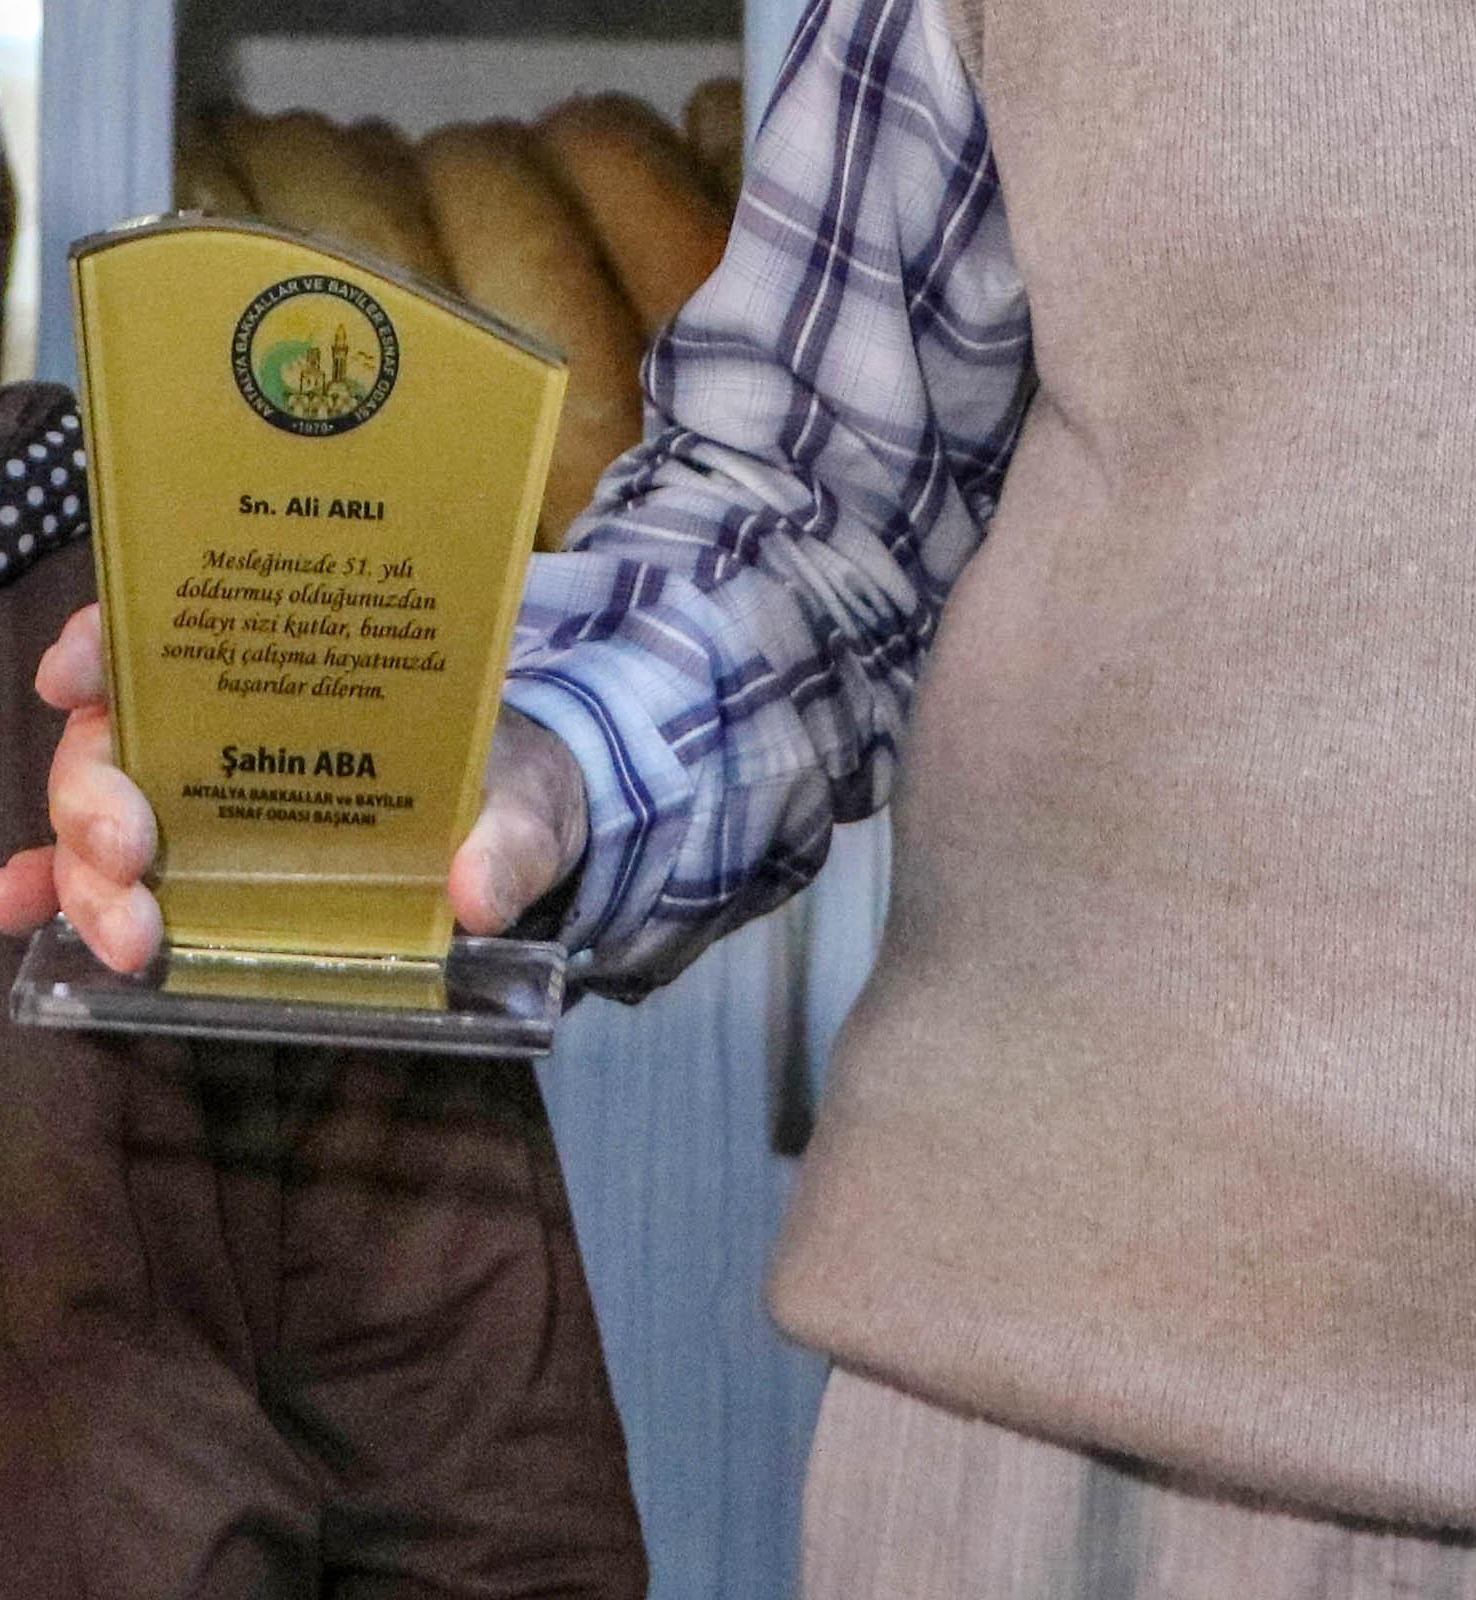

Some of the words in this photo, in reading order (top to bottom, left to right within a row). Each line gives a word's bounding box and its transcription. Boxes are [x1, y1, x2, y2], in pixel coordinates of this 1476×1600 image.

[302, 279, 324, 290] VE
[235, 279, 299, 350] BAKKALLAR
[236, 356, 274, 416] ANTALYA
[238, 494, 276, 515] Sn.
[285, 496, 319, 518] Ali
[327, 499, 385, 520] ARLI
[202, 549, 336, 577] Mesleğinizde
[342, 556, 372, 576] 51.
[377, 556, 413, 584] yılı
[176, 576, 284, 606] doldurmuş
[289, 583, 437, 612] olduğunuzdan
[173, 608, 235, 636] dolayı
[241, 612, 277, 632] sizi
[283, 613, 351, 639] kutlar,
[360, 616, 437, 640] bundan
[161, 640, 236, 666] sonraki
[241, 642, 316, 668] çalışma
[324, 646, 446, 673] hayatınızda
[217, 671, 308, 697] başarılar
[311, 675, 385, 699] dilerim.
[221, 745, 305, 778] Şahin
[314, 750, 376, 778] ABA
[182, 784, 246, 798] ANTALYA
[218, 805, 263, 819] ESNAF
[313, 810, 376, 827] BAŞKANI
